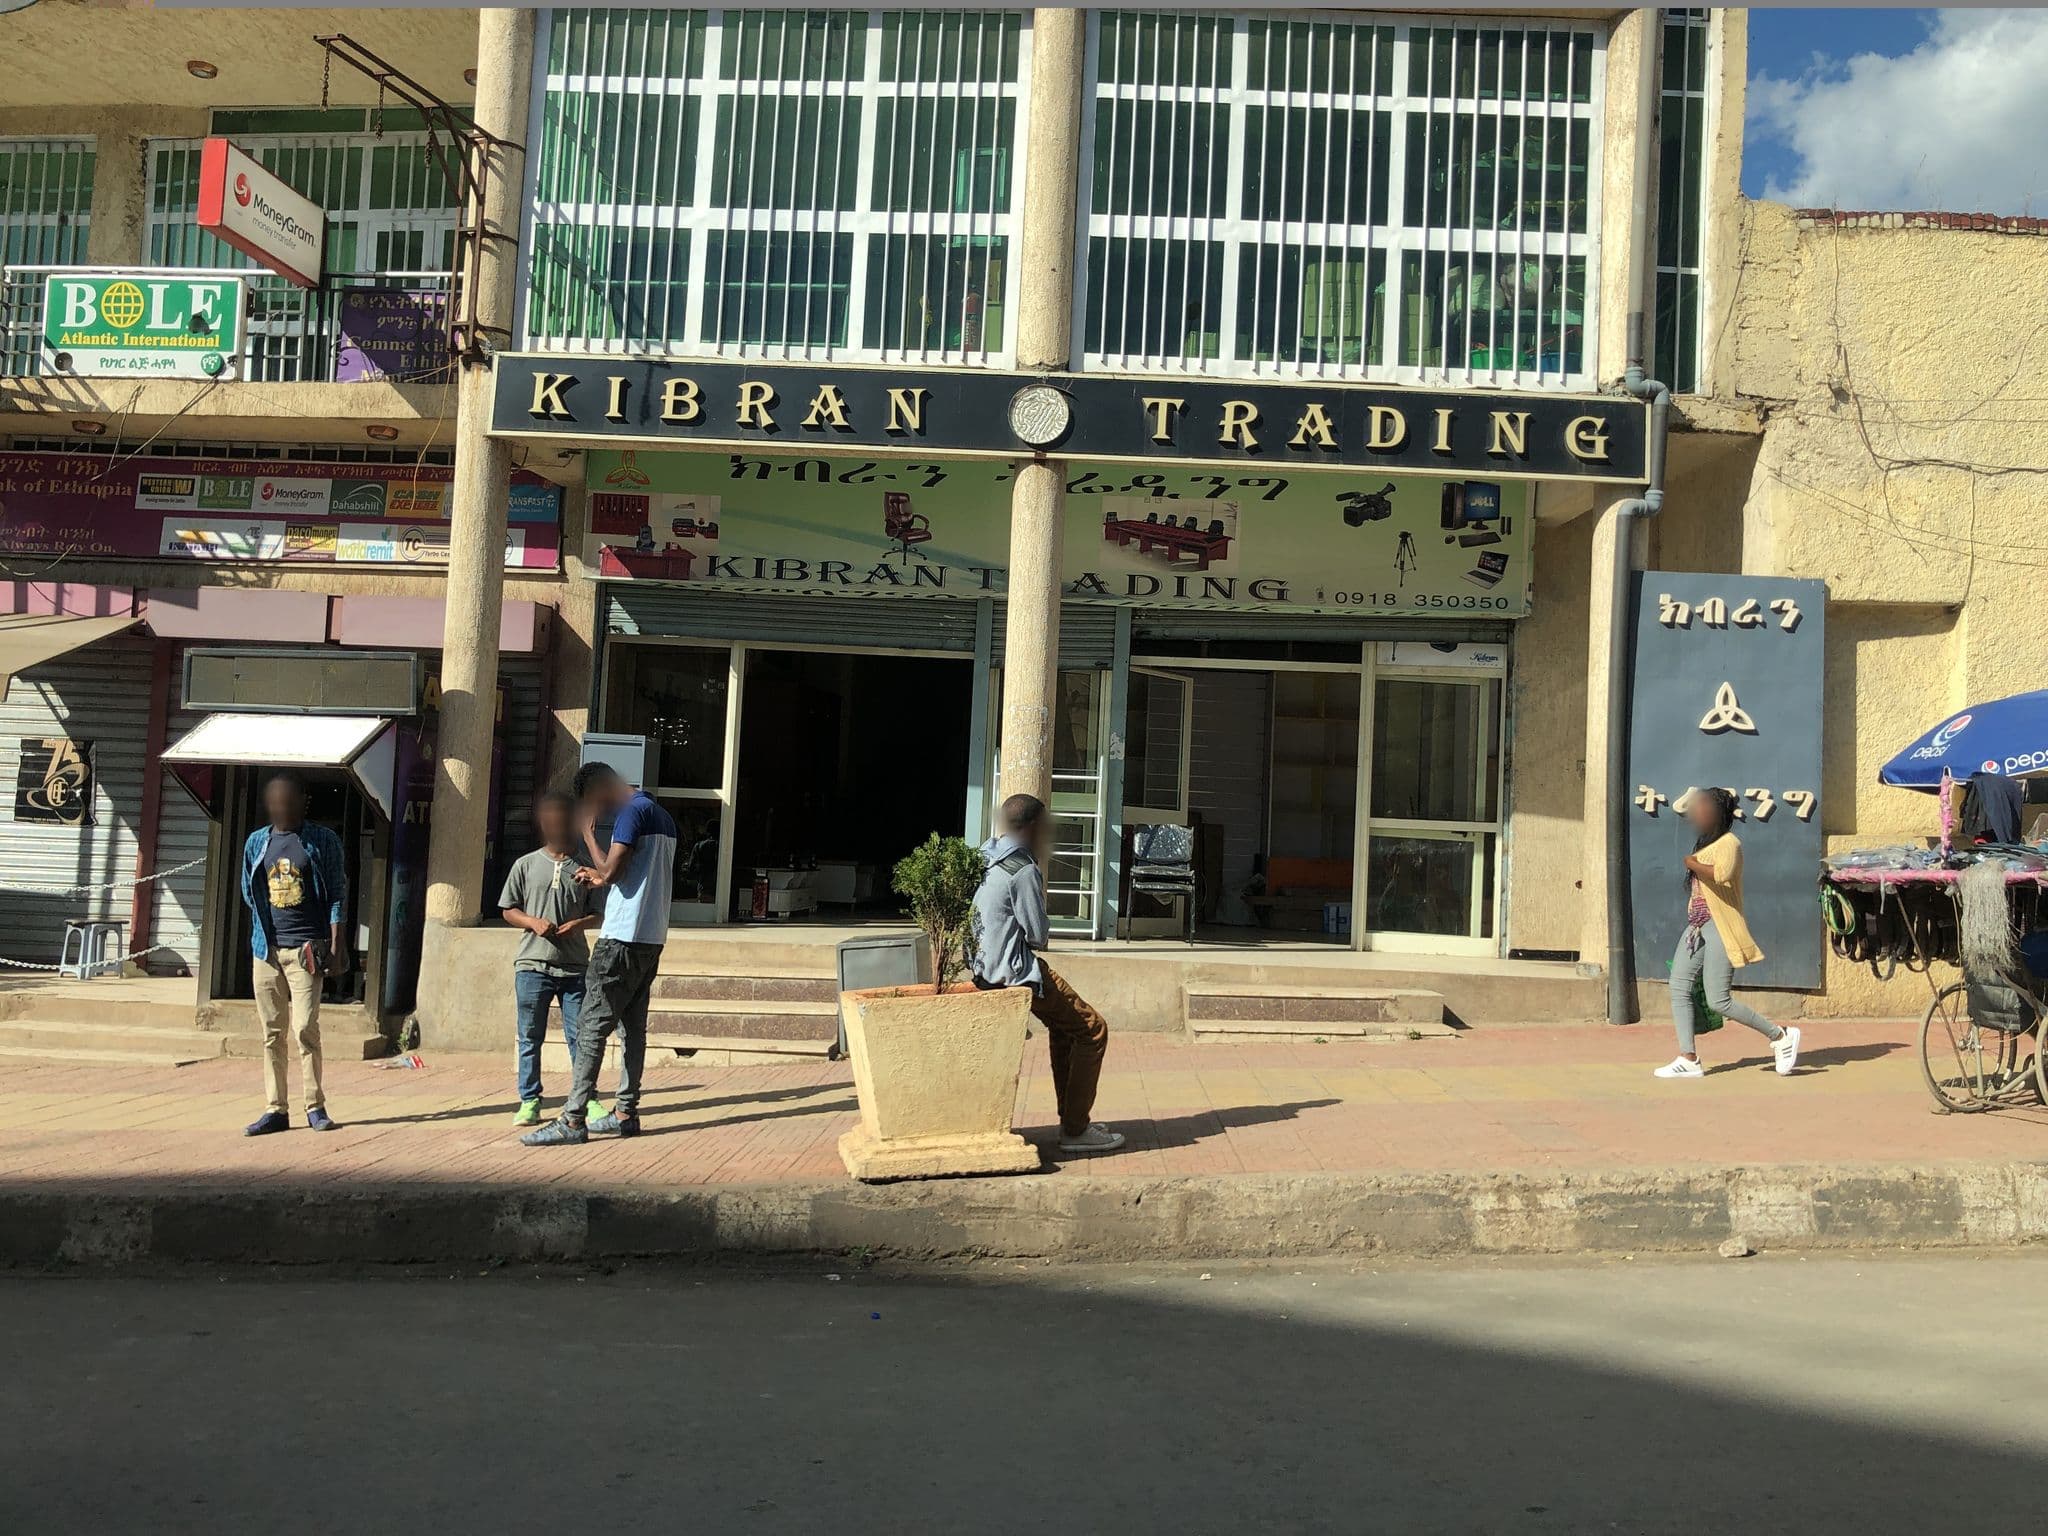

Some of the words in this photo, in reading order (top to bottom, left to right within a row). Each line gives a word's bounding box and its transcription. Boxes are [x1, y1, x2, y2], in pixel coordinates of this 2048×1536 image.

[253, 194, 315, 246] MoneyGram
[60, 332, 119, 346] Atlantic
[122, 332, 220, 347] International
[528, 371, 929, 432] KIBRAN
[1141, 397, 1610, 459] TRADING
[730, 455, 949, 488] ክብራን
[23, 479, 45, 493] of
[49, 480, 133, 499] Ethiopia
[275, 488, 324, 502] MoneyGram
[508, 495, 545, 508] RANSFAST
[337, 539, 394, 560] worldremit
[706, 555, 950, 588] KIBRAN
[968, 566, 1291, 601] TADING
[1335, 591, 1397, 606] 0918
[1414, 594, 1509, 610] 350350
[1659, 593, 1801, 628] ክብራን
[1909, 744, 1951, 761] pepsi
[2004, 750, 2048, 774] pep
[402, 801, 431, 825] AT
[1634, 784, 1815, 819] ትንግ
